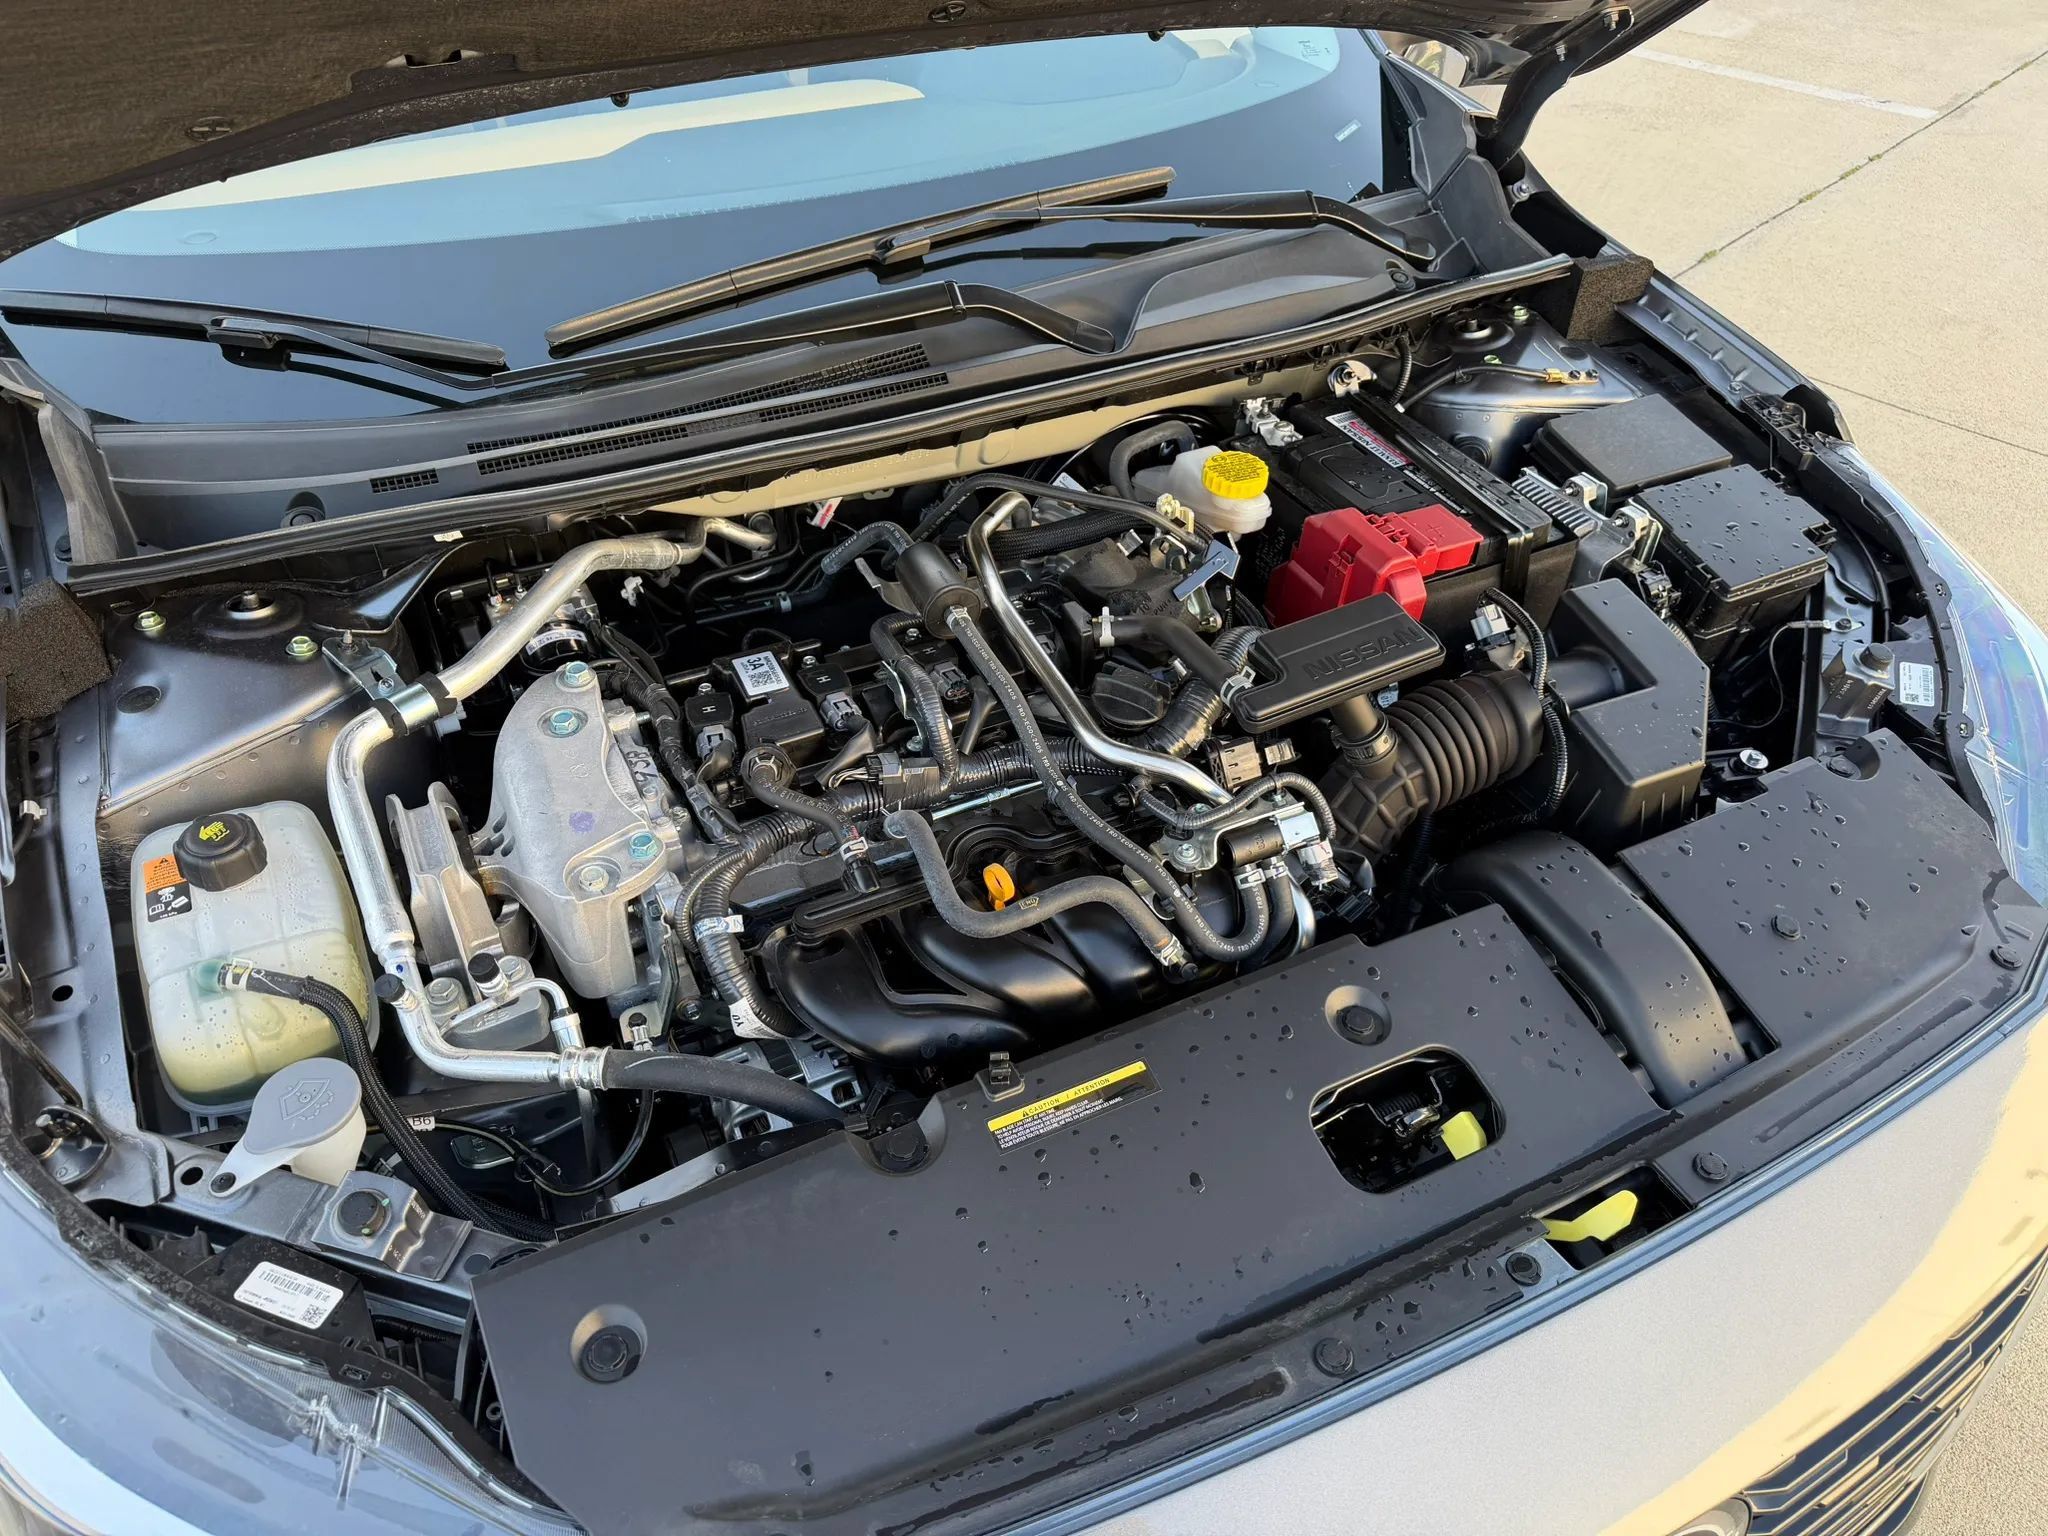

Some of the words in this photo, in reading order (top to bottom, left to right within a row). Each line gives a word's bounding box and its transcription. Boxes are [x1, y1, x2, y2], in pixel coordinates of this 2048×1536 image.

[1341, 424, 1373, 447] NISSAN
[1304, 625, 1425, 680] NISSAN
[747, 657, 765, 671] 3A
[816, 675, 831, 684] H
[702, 704, 716, 713] H
[1028, 1099, 1060, 1114] CAUTION
[1074, 1078, 1111, 1096] ATTENTION
[411, 1116, 432, 1127] B6
